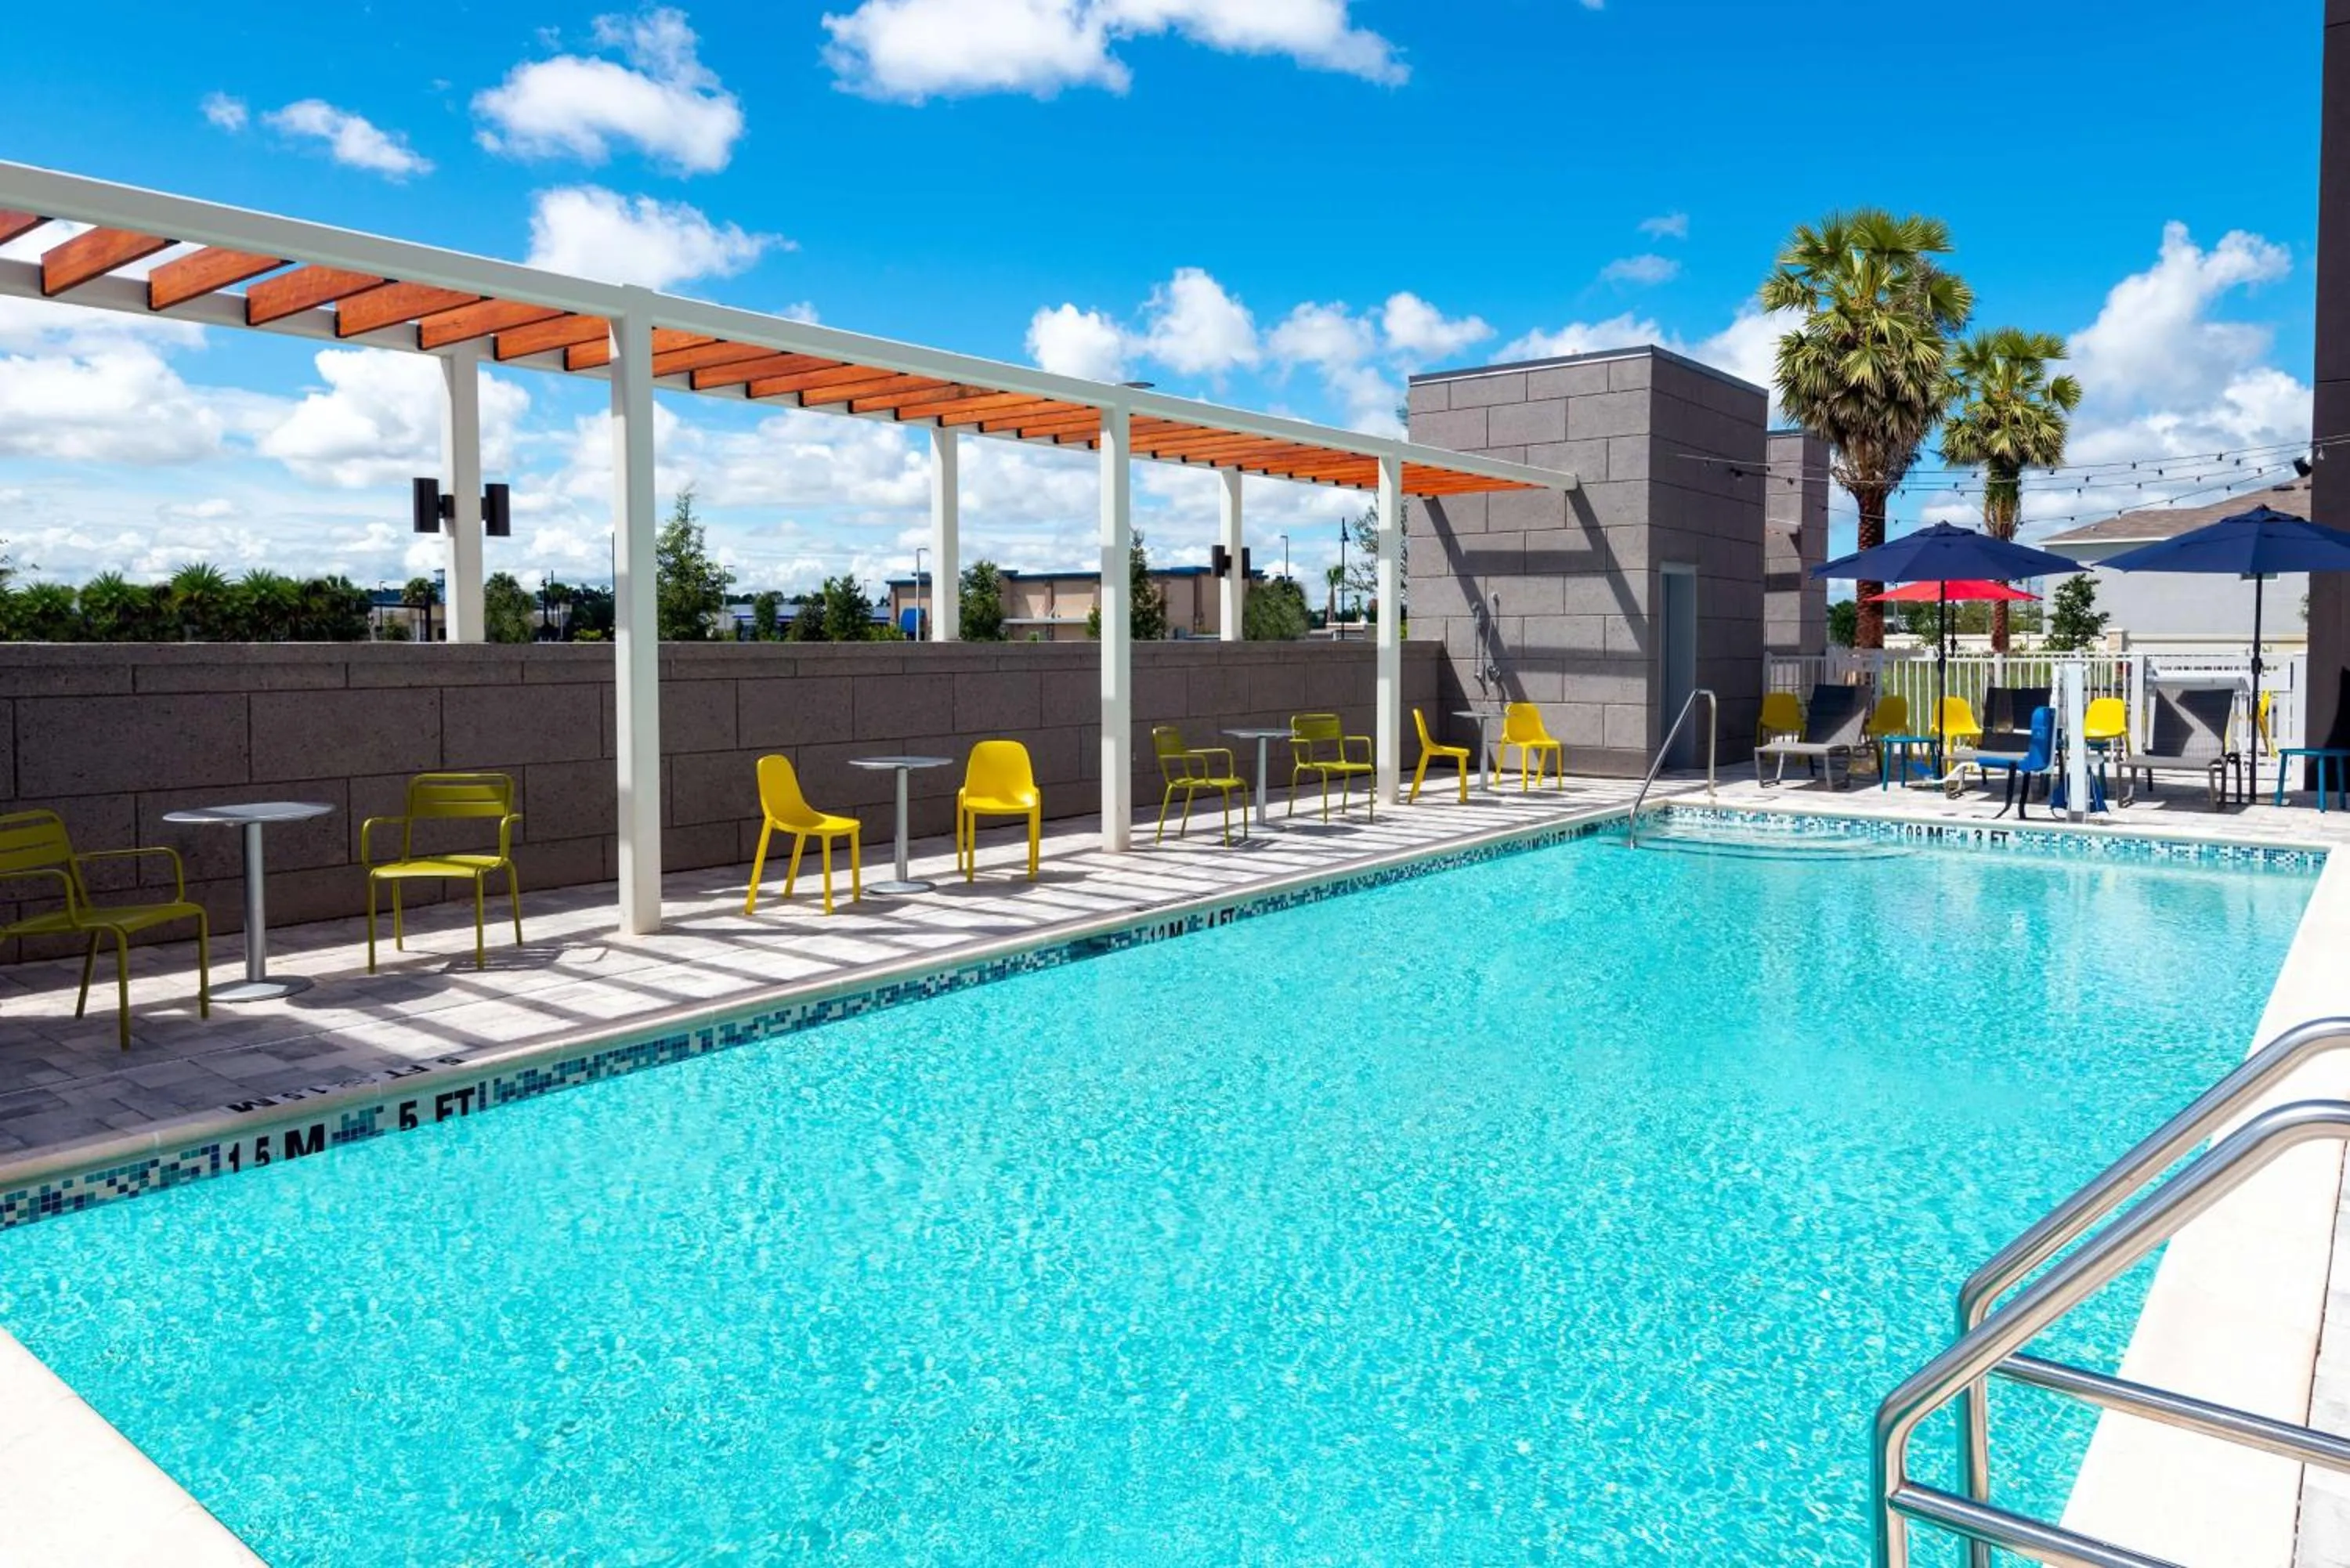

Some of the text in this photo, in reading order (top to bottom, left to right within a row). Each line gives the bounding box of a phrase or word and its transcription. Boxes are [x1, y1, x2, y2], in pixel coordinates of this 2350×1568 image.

[1927, 826, 1943, 837] M
[1990, 830, 2010, 843] FT
[399, 1100, 418, 1132] 5
[435, 1086, 475, 1123] FT
